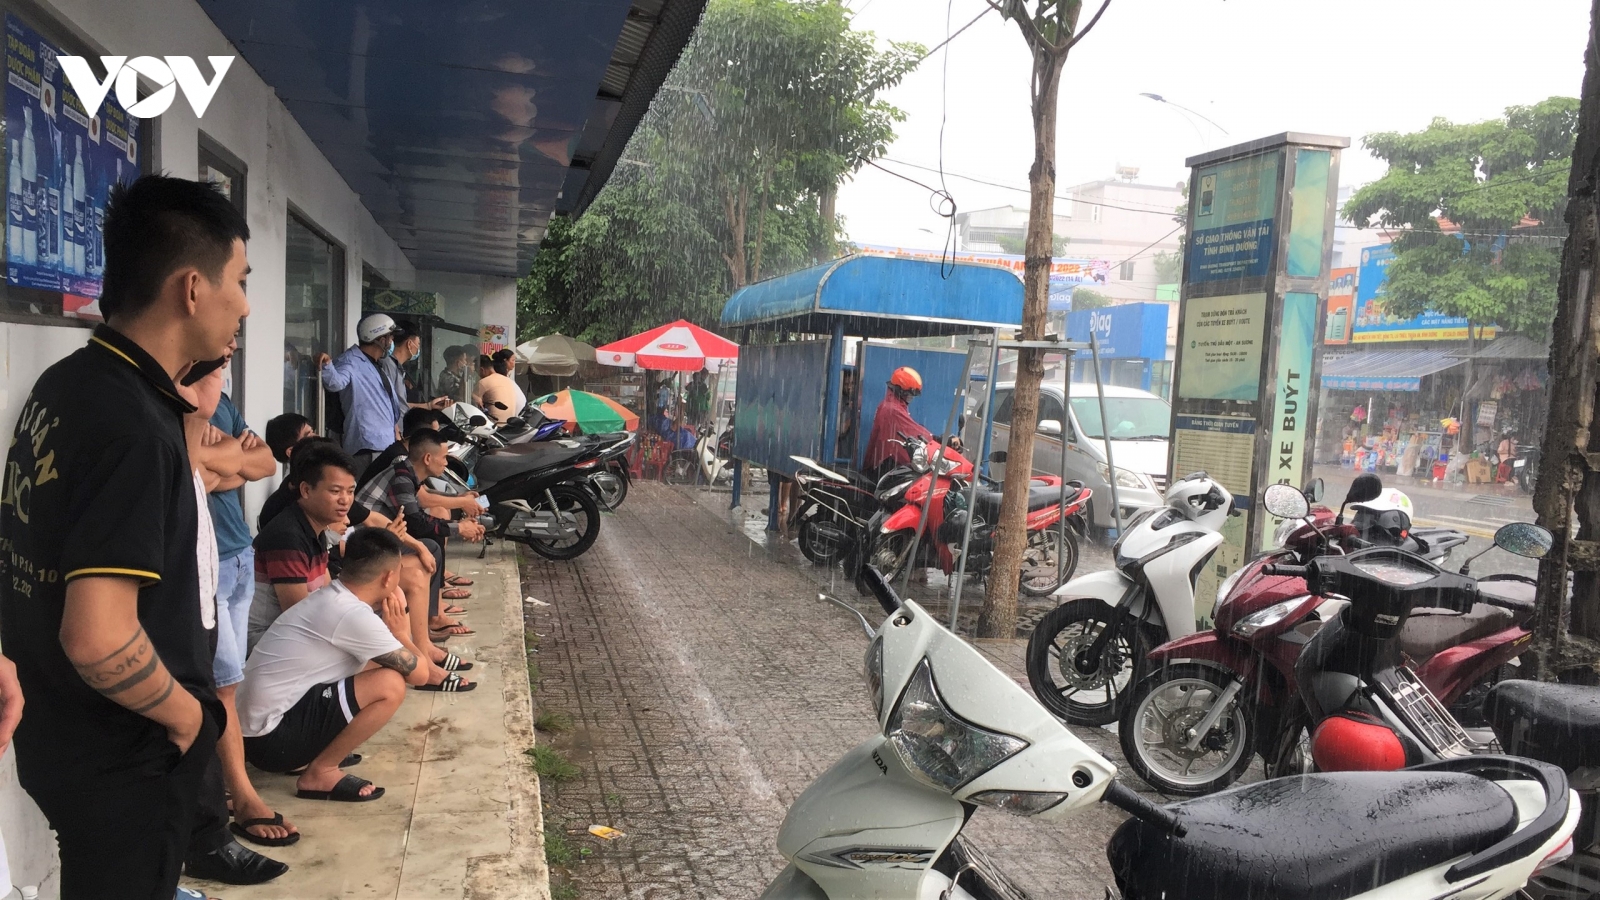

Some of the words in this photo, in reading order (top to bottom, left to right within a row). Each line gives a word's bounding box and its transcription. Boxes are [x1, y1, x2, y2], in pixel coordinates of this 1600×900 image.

[1196, 233, 1204, 245] SỞ
[1205, 234, 1219, 244] GIAO
[1220, 230, 1242, 242] THÔNG
[1243, 227, 1256, 239] VẬN
[1258, 224, 1269, 236] TẢI
[1204, 244, 1218, 256] TỈNH
[1219, 243, 1234, 254] BÌNH
[1236, 240, 1257, 252] DƯƠNG
[1056, 264, 1081, 273] 2022
[1283, 368, 1300, 431] BUÝT
[1224, 420, 1239, 428] TUYẾN
[1279, 441, 1293, 470] XE
